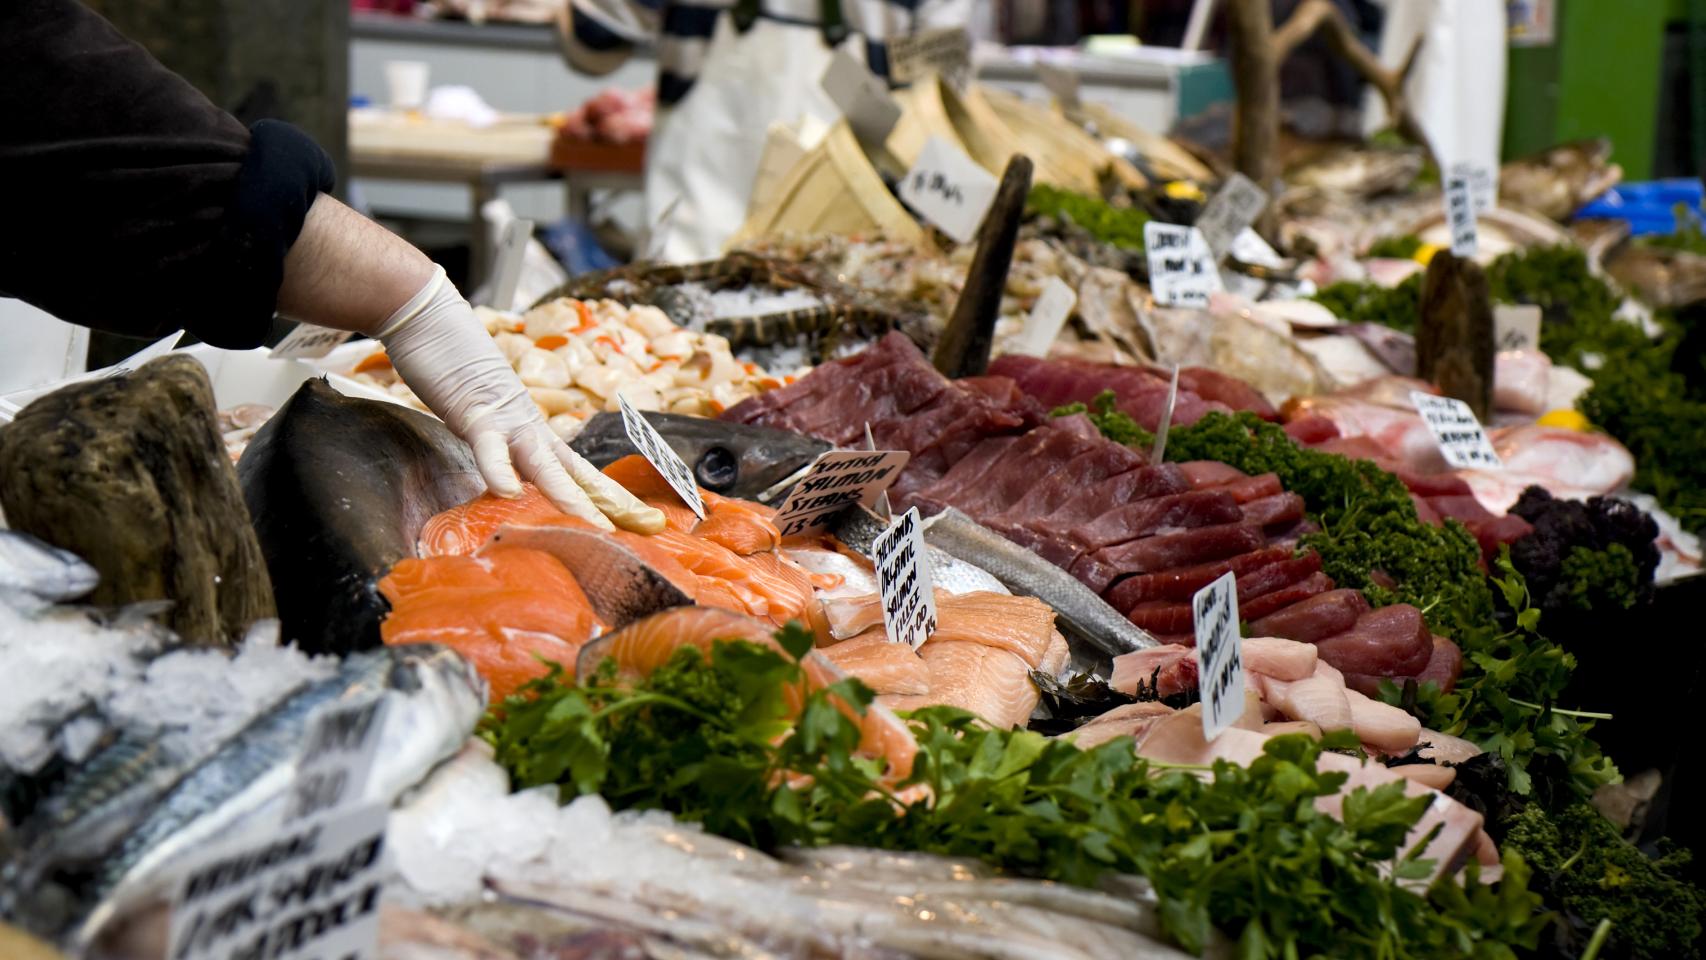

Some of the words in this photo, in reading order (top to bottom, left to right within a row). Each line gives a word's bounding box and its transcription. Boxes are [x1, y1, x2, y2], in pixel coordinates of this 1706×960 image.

[780, 487, 865, 516] STEAKS
[792, 465, 897, 497] SALMON
[881, 538, 915, 598] ORGANIC
[887, 561, 917, 626] SALMON
[895, 586, 920, 642] FILLET
